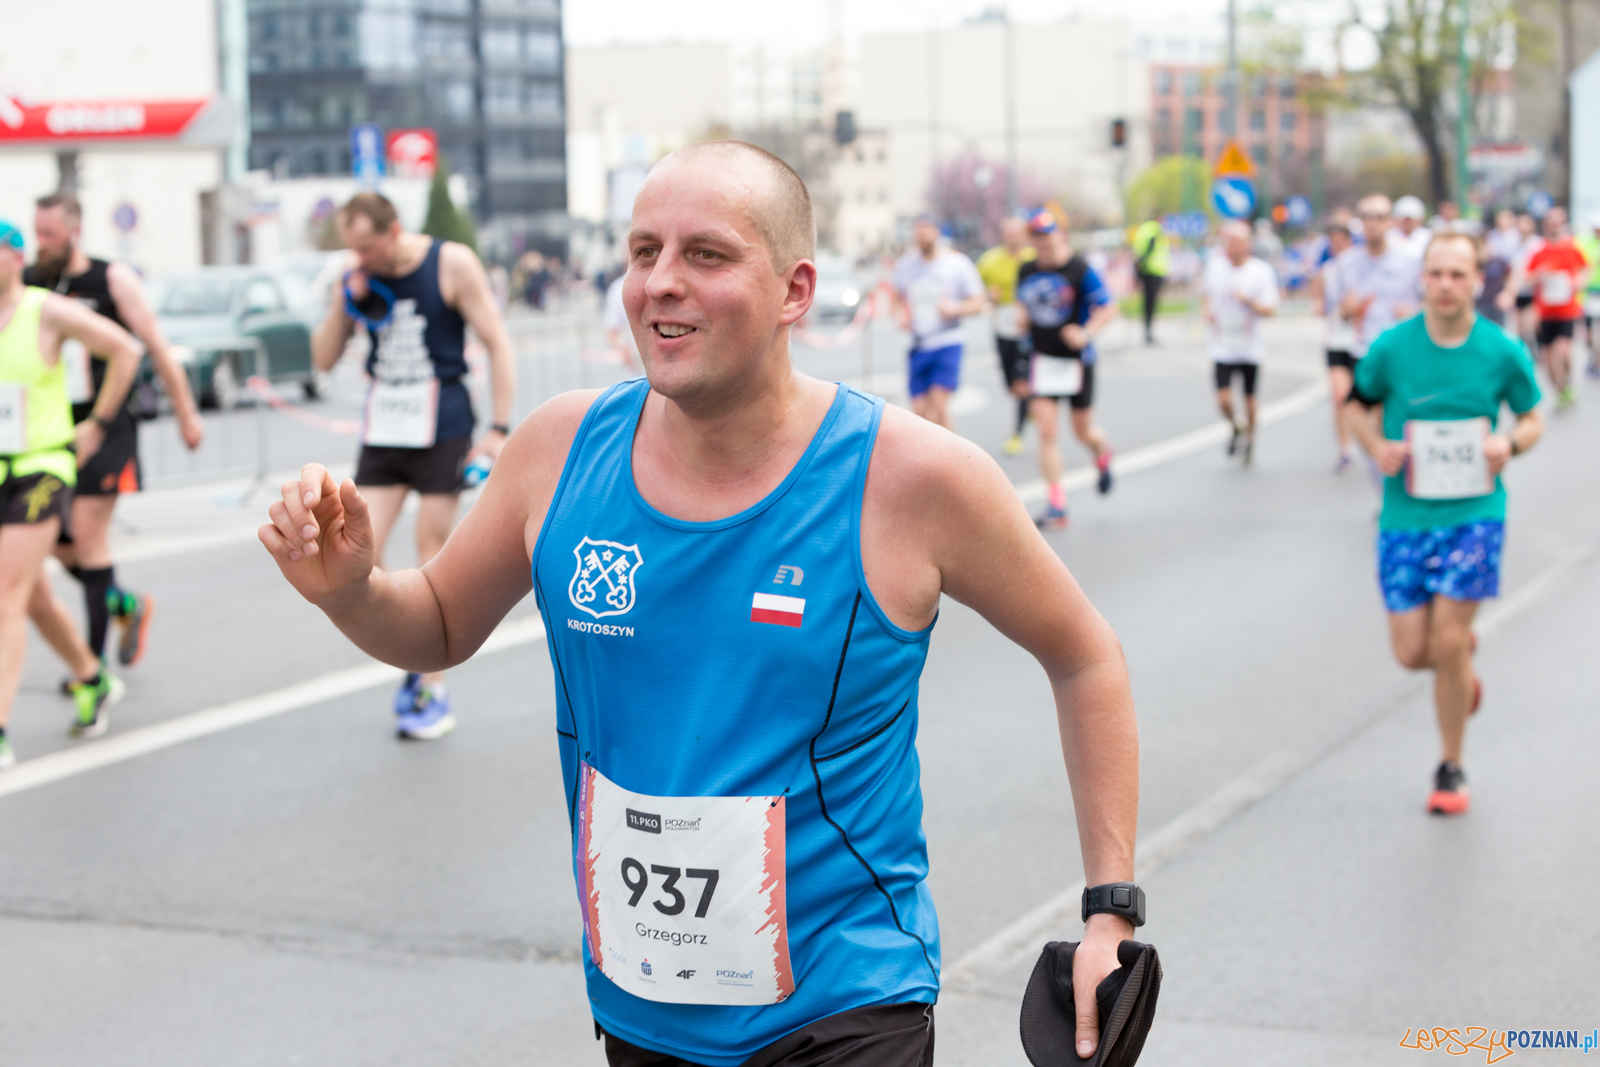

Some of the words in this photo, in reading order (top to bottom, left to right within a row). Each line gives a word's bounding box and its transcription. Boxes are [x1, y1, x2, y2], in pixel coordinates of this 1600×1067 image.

[567, 618, 635, 637] KROTOSZYN
[620, 857, 719, 918] 937
[635, 923, 708, 946] Grzegorz
[676, 969, 697, 979] 4F
